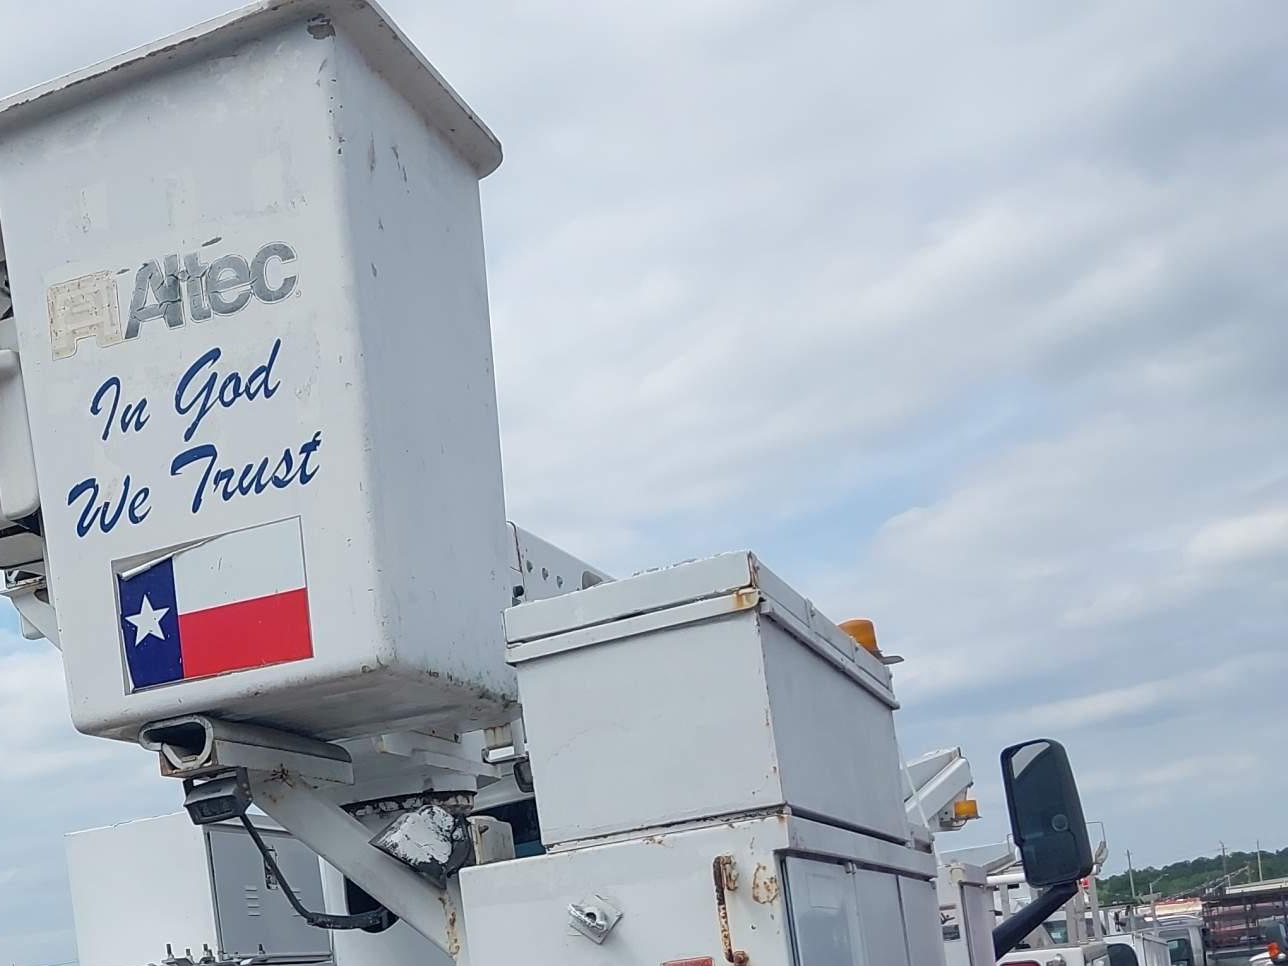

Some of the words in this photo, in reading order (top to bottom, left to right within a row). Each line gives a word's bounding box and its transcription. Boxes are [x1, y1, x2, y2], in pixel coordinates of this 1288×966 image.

[124, 242, 297, 341] Altec
[90, 376, 151, 441] In
[174, 338, 282, 442] God
[67, 474, 151, 538] We
[170, 431, 322, 514] Trust
